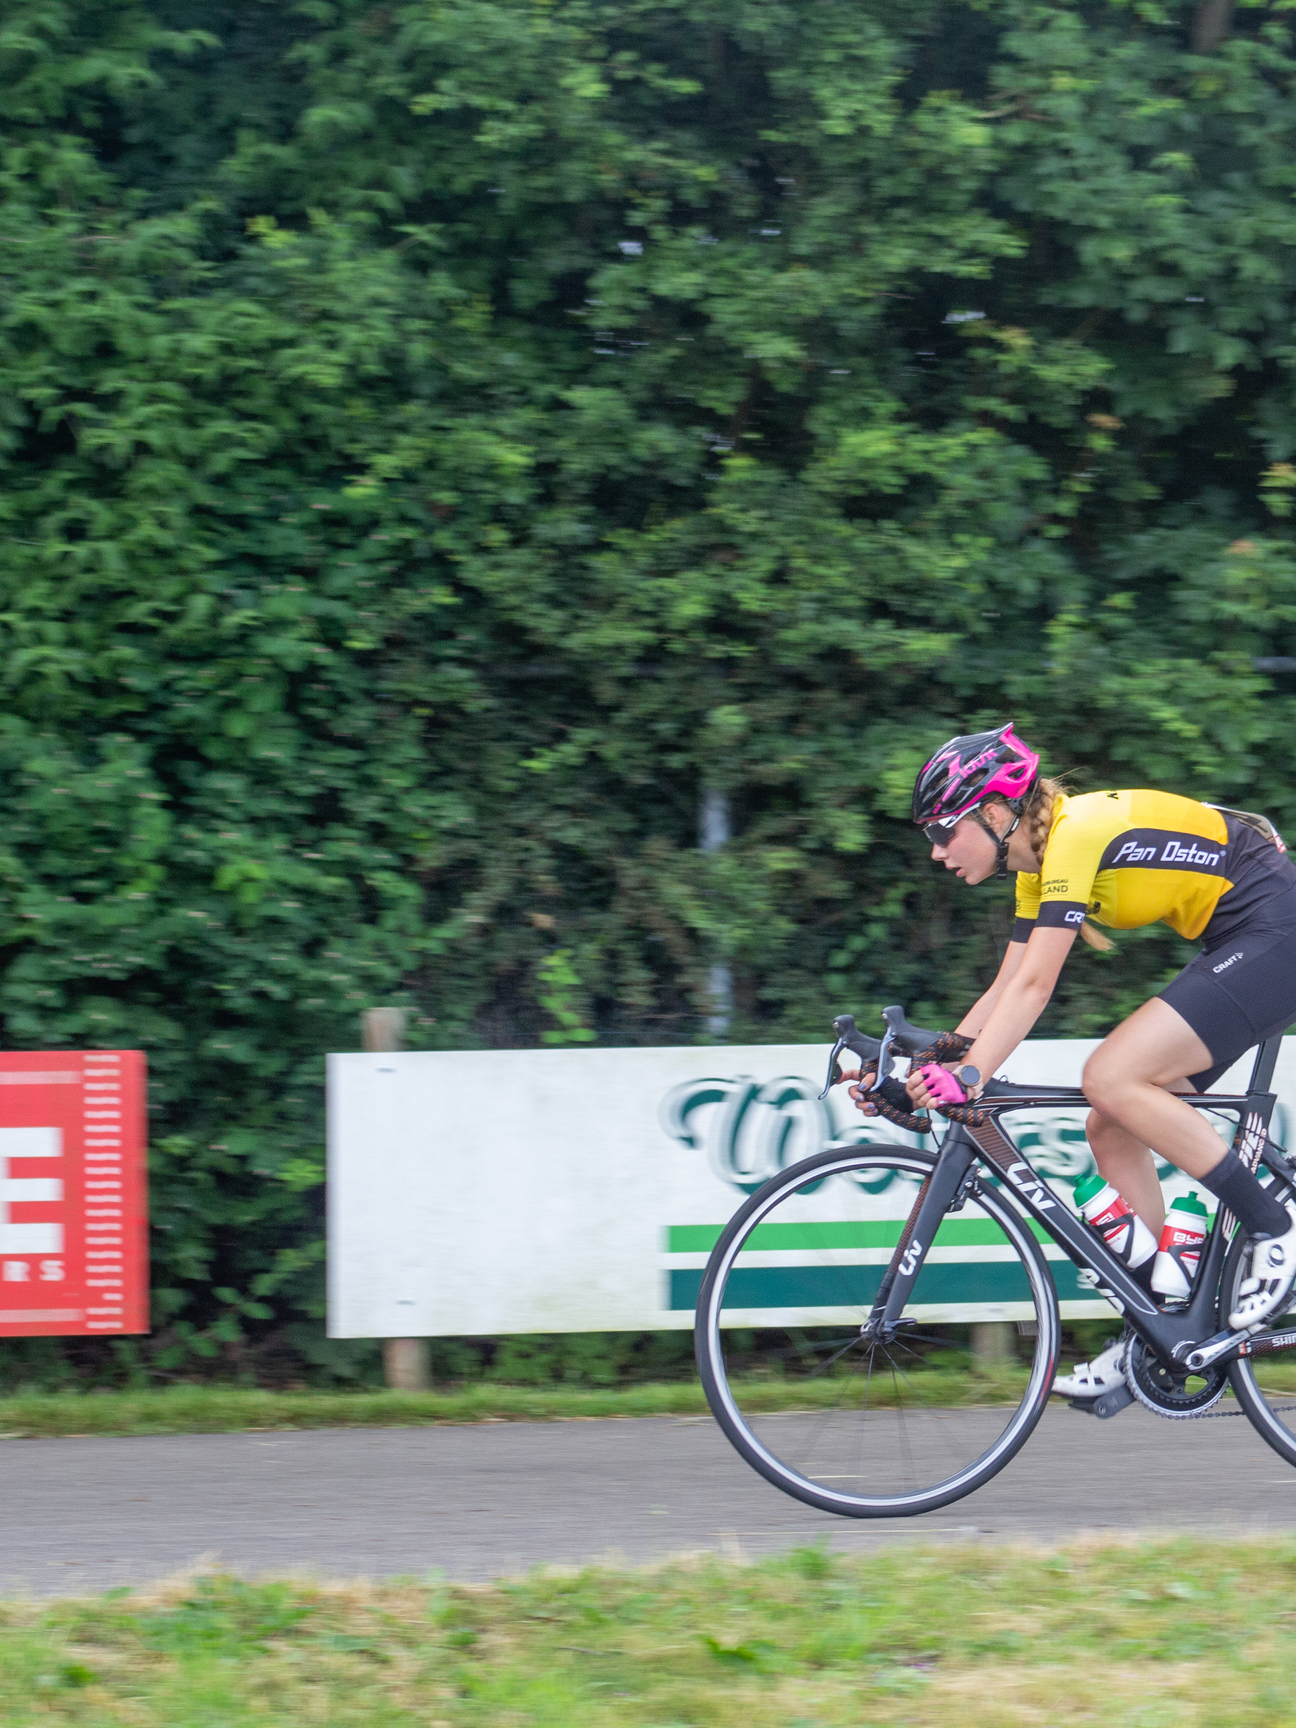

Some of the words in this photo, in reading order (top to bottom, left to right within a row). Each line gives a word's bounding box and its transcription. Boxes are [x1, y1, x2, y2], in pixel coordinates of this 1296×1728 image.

[958, 748, 998, 779] KASK
[1111, 841, 1157, 864] Pan
[1160, 841, 1220, 867] Oston
[1212, 954, 1238, 974] CRAFT
